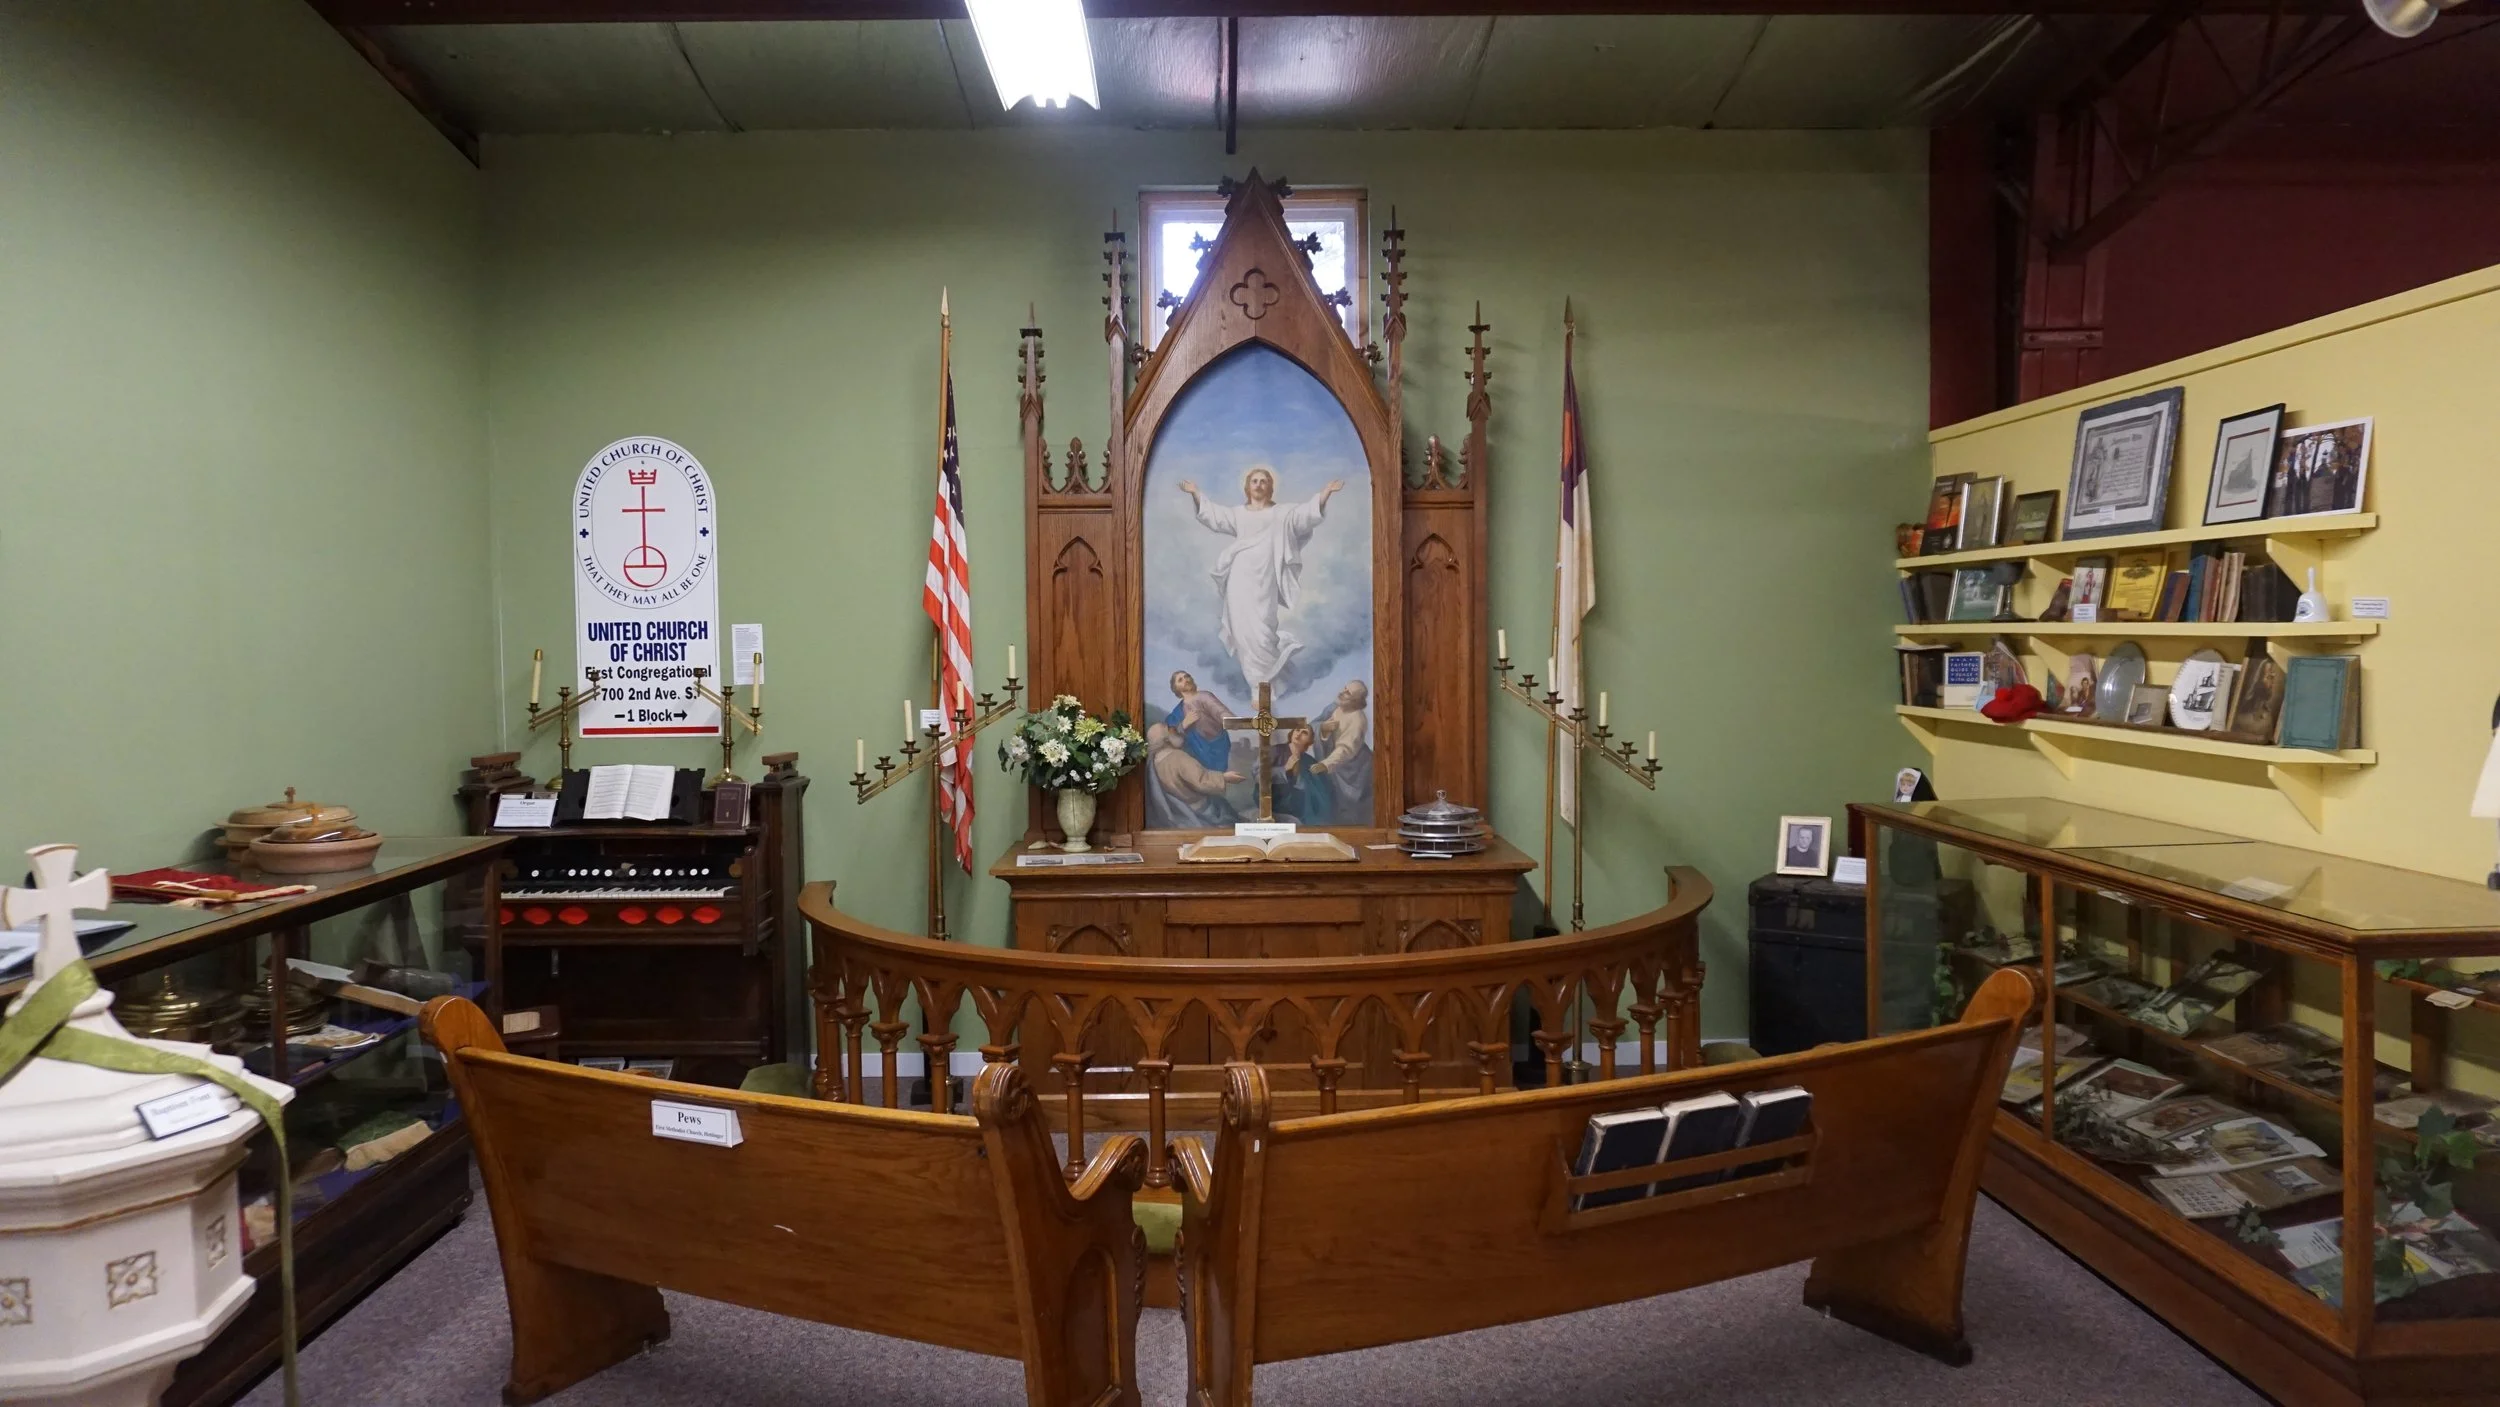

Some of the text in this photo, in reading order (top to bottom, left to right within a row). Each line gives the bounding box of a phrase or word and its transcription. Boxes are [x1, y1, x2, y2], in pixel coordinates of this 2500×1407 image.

[580, 443, 708, 518] UNITED CHURCH OF CHRIST
[584, 553, 707, 604] THAT THEY MAY ALL BE ONE
[587, 620, 708, 641] UNITED CHURCH
[610, 642, 687, 662] OF CHRIST
[617, 665, 711, 681] Congregatioal
[601, 686, 697, 701] 700 2nd Ave. S.
[627, 709, 673, 722] 1 Block
[677, 1111, 702, 1125] Pews
[665, 1125, 686, 1134] Methodist
[686, 1128, 703, 1136] Church,
